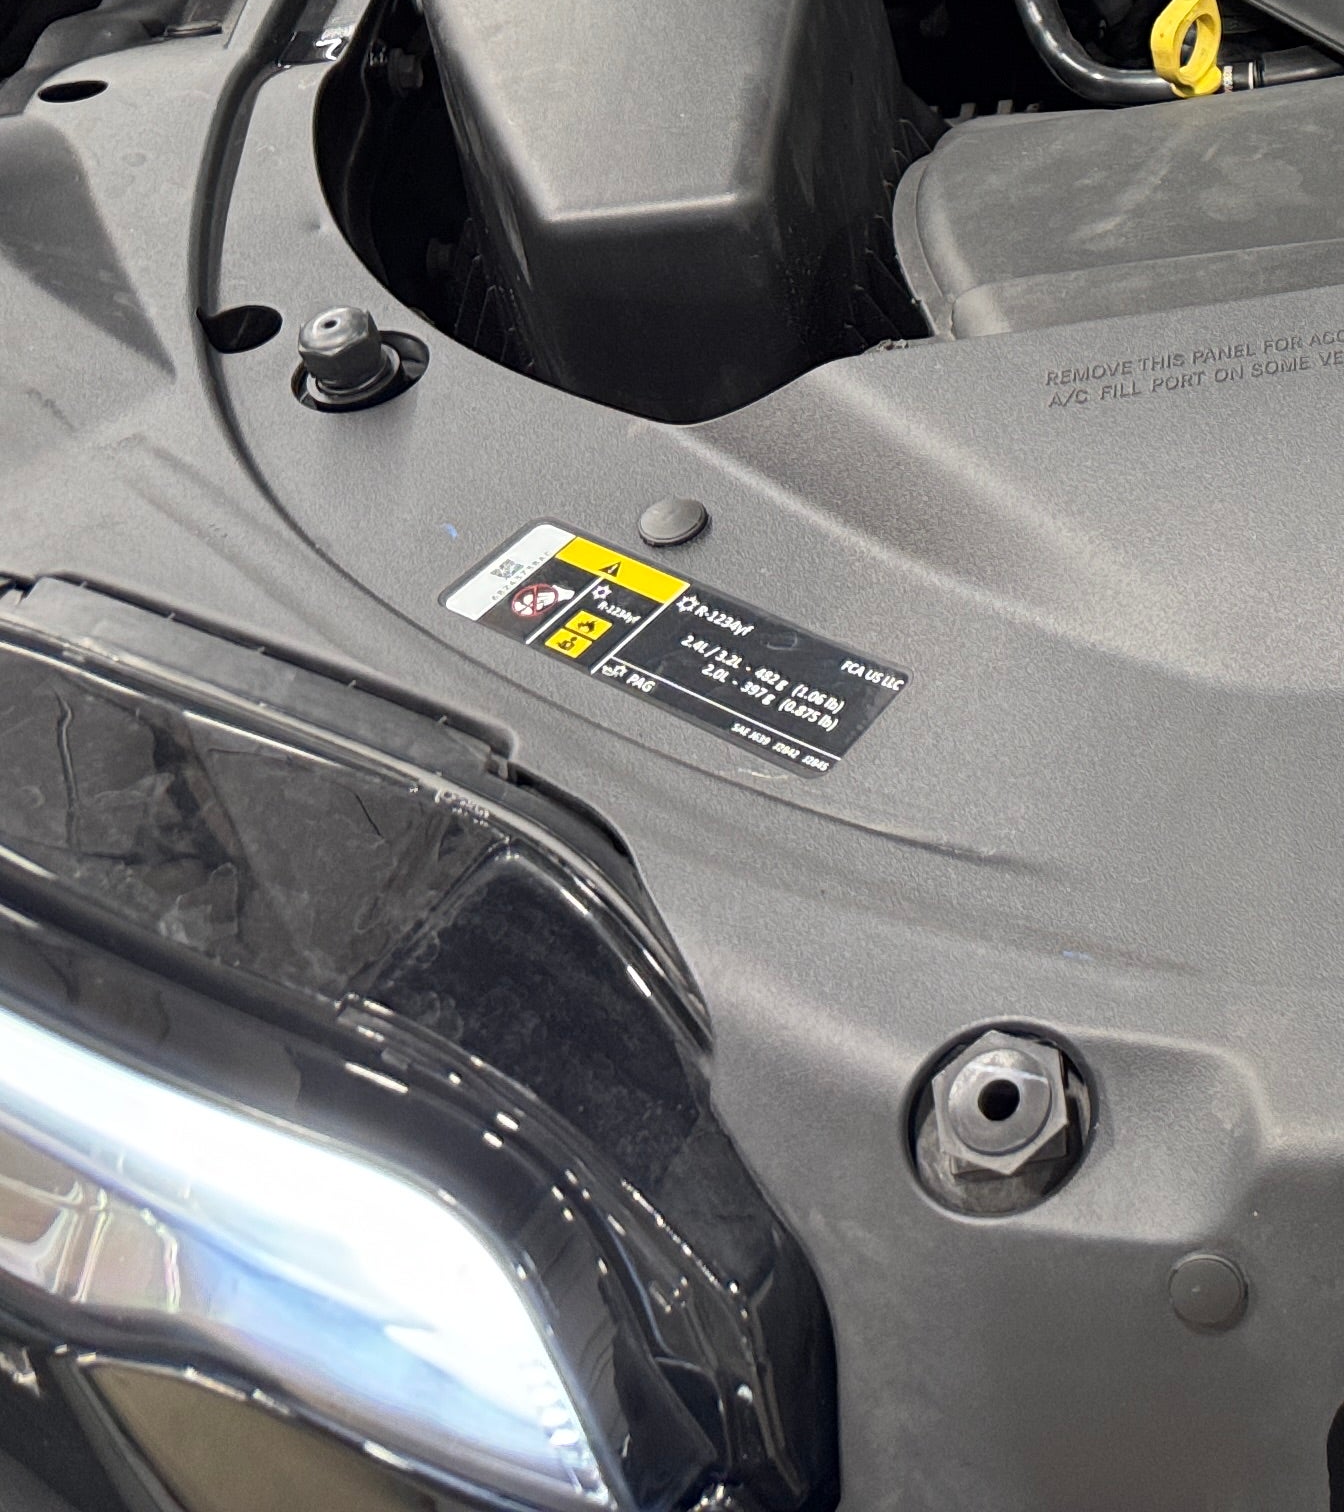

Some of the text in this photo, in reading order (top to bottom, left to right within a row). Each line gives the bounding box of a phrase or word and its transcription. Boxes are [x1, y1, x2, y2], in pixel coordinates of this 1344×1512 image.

[1045, 360, 1133, 386] REMOVE
[1138, 354, 1185, 372] THIS
[1193, 344, 1256, 365] PANEL
[1263, 337, 1302, 354] FOR
[1048, 389, 1089, 408] A/C
[1100, 381, 1142, 400] FILL
[1151, 371, 1206, 393] PORT
[1214, 364, 1244, 383] ON
[1251, 356, 1311, 378] SOME
[597, 600, 642, 624] R-1234yf
[694, 605, 755, 637] R-1234yf
[715, 650, 743, 669] 3.2L
[625, 673, 656, 693] PAG
[701, 663, 730, 683] 2.0L
[840, 660, 905, 691] FCA US LLC
[730, 722, 751, 737] SAE
[748, 730, 771, 746] J639
